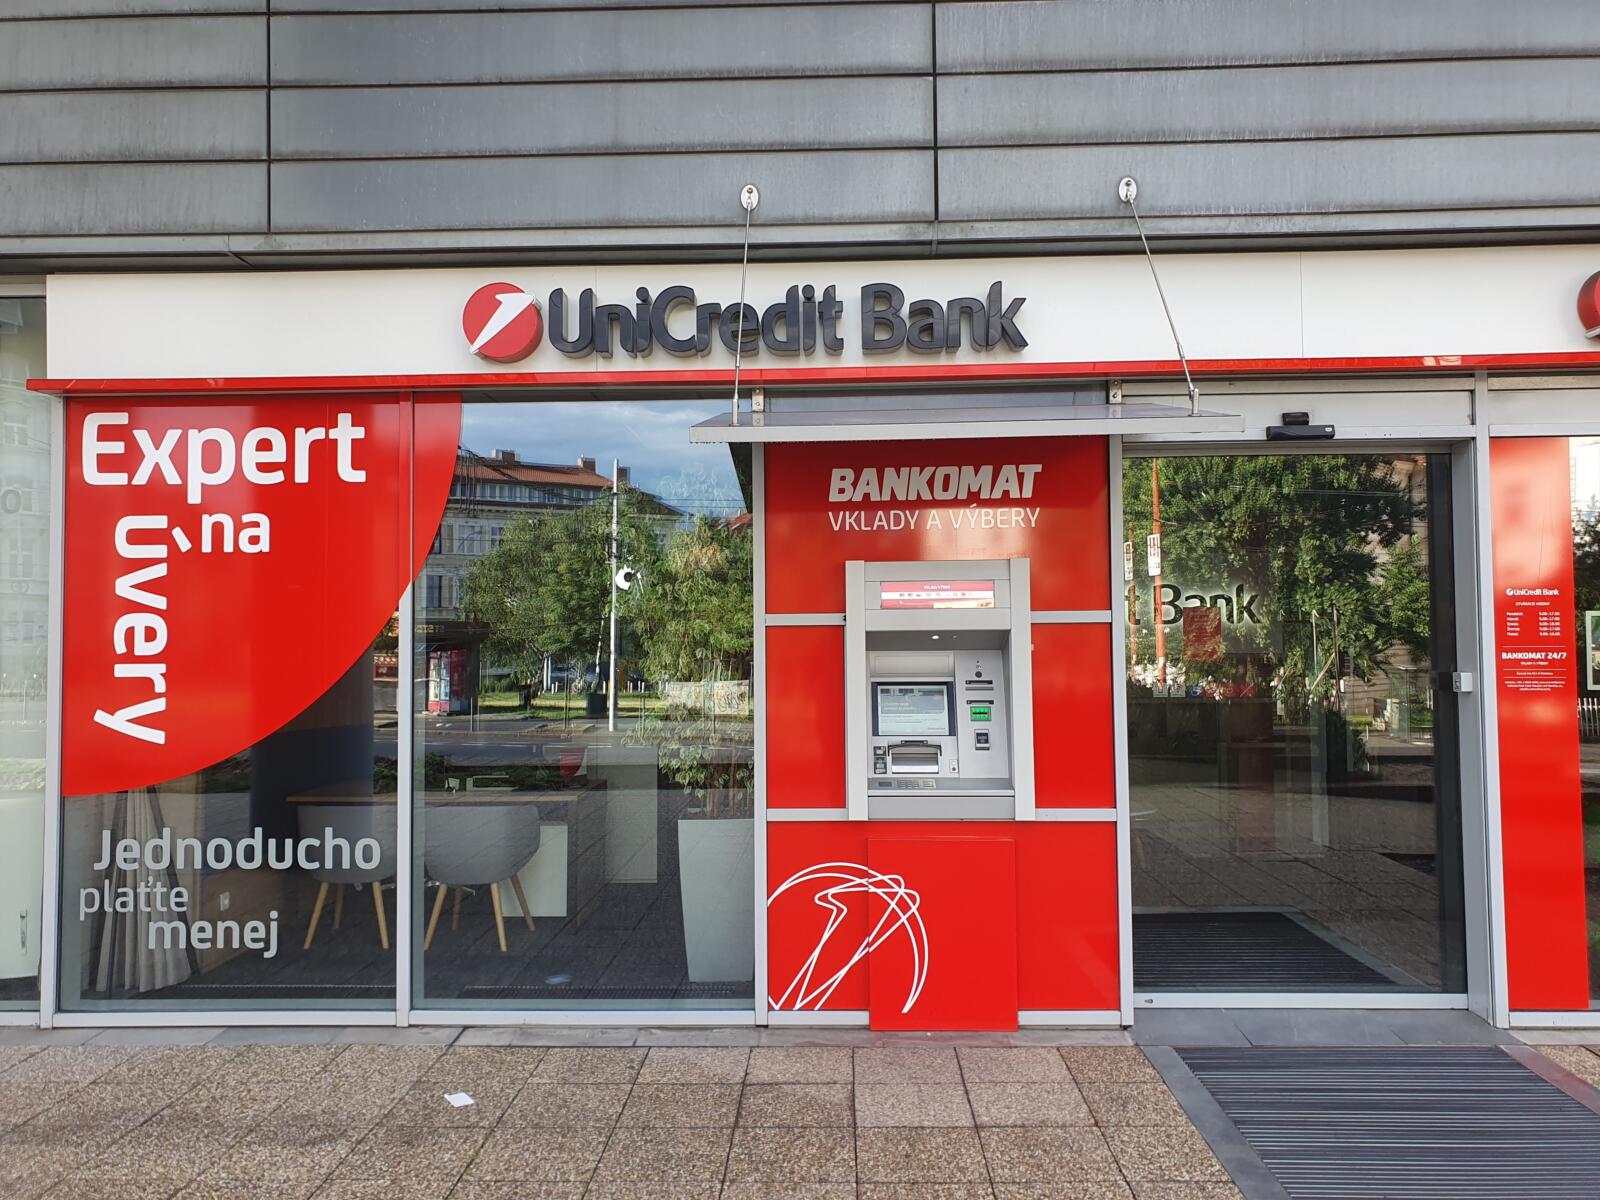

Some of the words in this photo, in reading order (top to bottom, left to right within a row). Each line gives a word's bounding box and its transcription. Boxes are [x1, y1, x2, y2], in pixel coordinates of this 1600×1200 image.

[549, 284, 844, 359] UniCredit
[861, 281, 1029, 355] Bank
[82, 413, 366, 504] Expert
[829, 464, 1042, 502] BANKOMAT
[202, 513, 270, 553] na
[829, 510, 919, 531] VKLADY
[926, 510, 942, 529] A
[949, 503, 1040, 528] VÝBERY
[94, 515, 192, 744] úvery
[94, 827, 381, 870] Jednoducho
[80, 876, 189, 921] plaťte
[149, 911, 278, 958] menej
